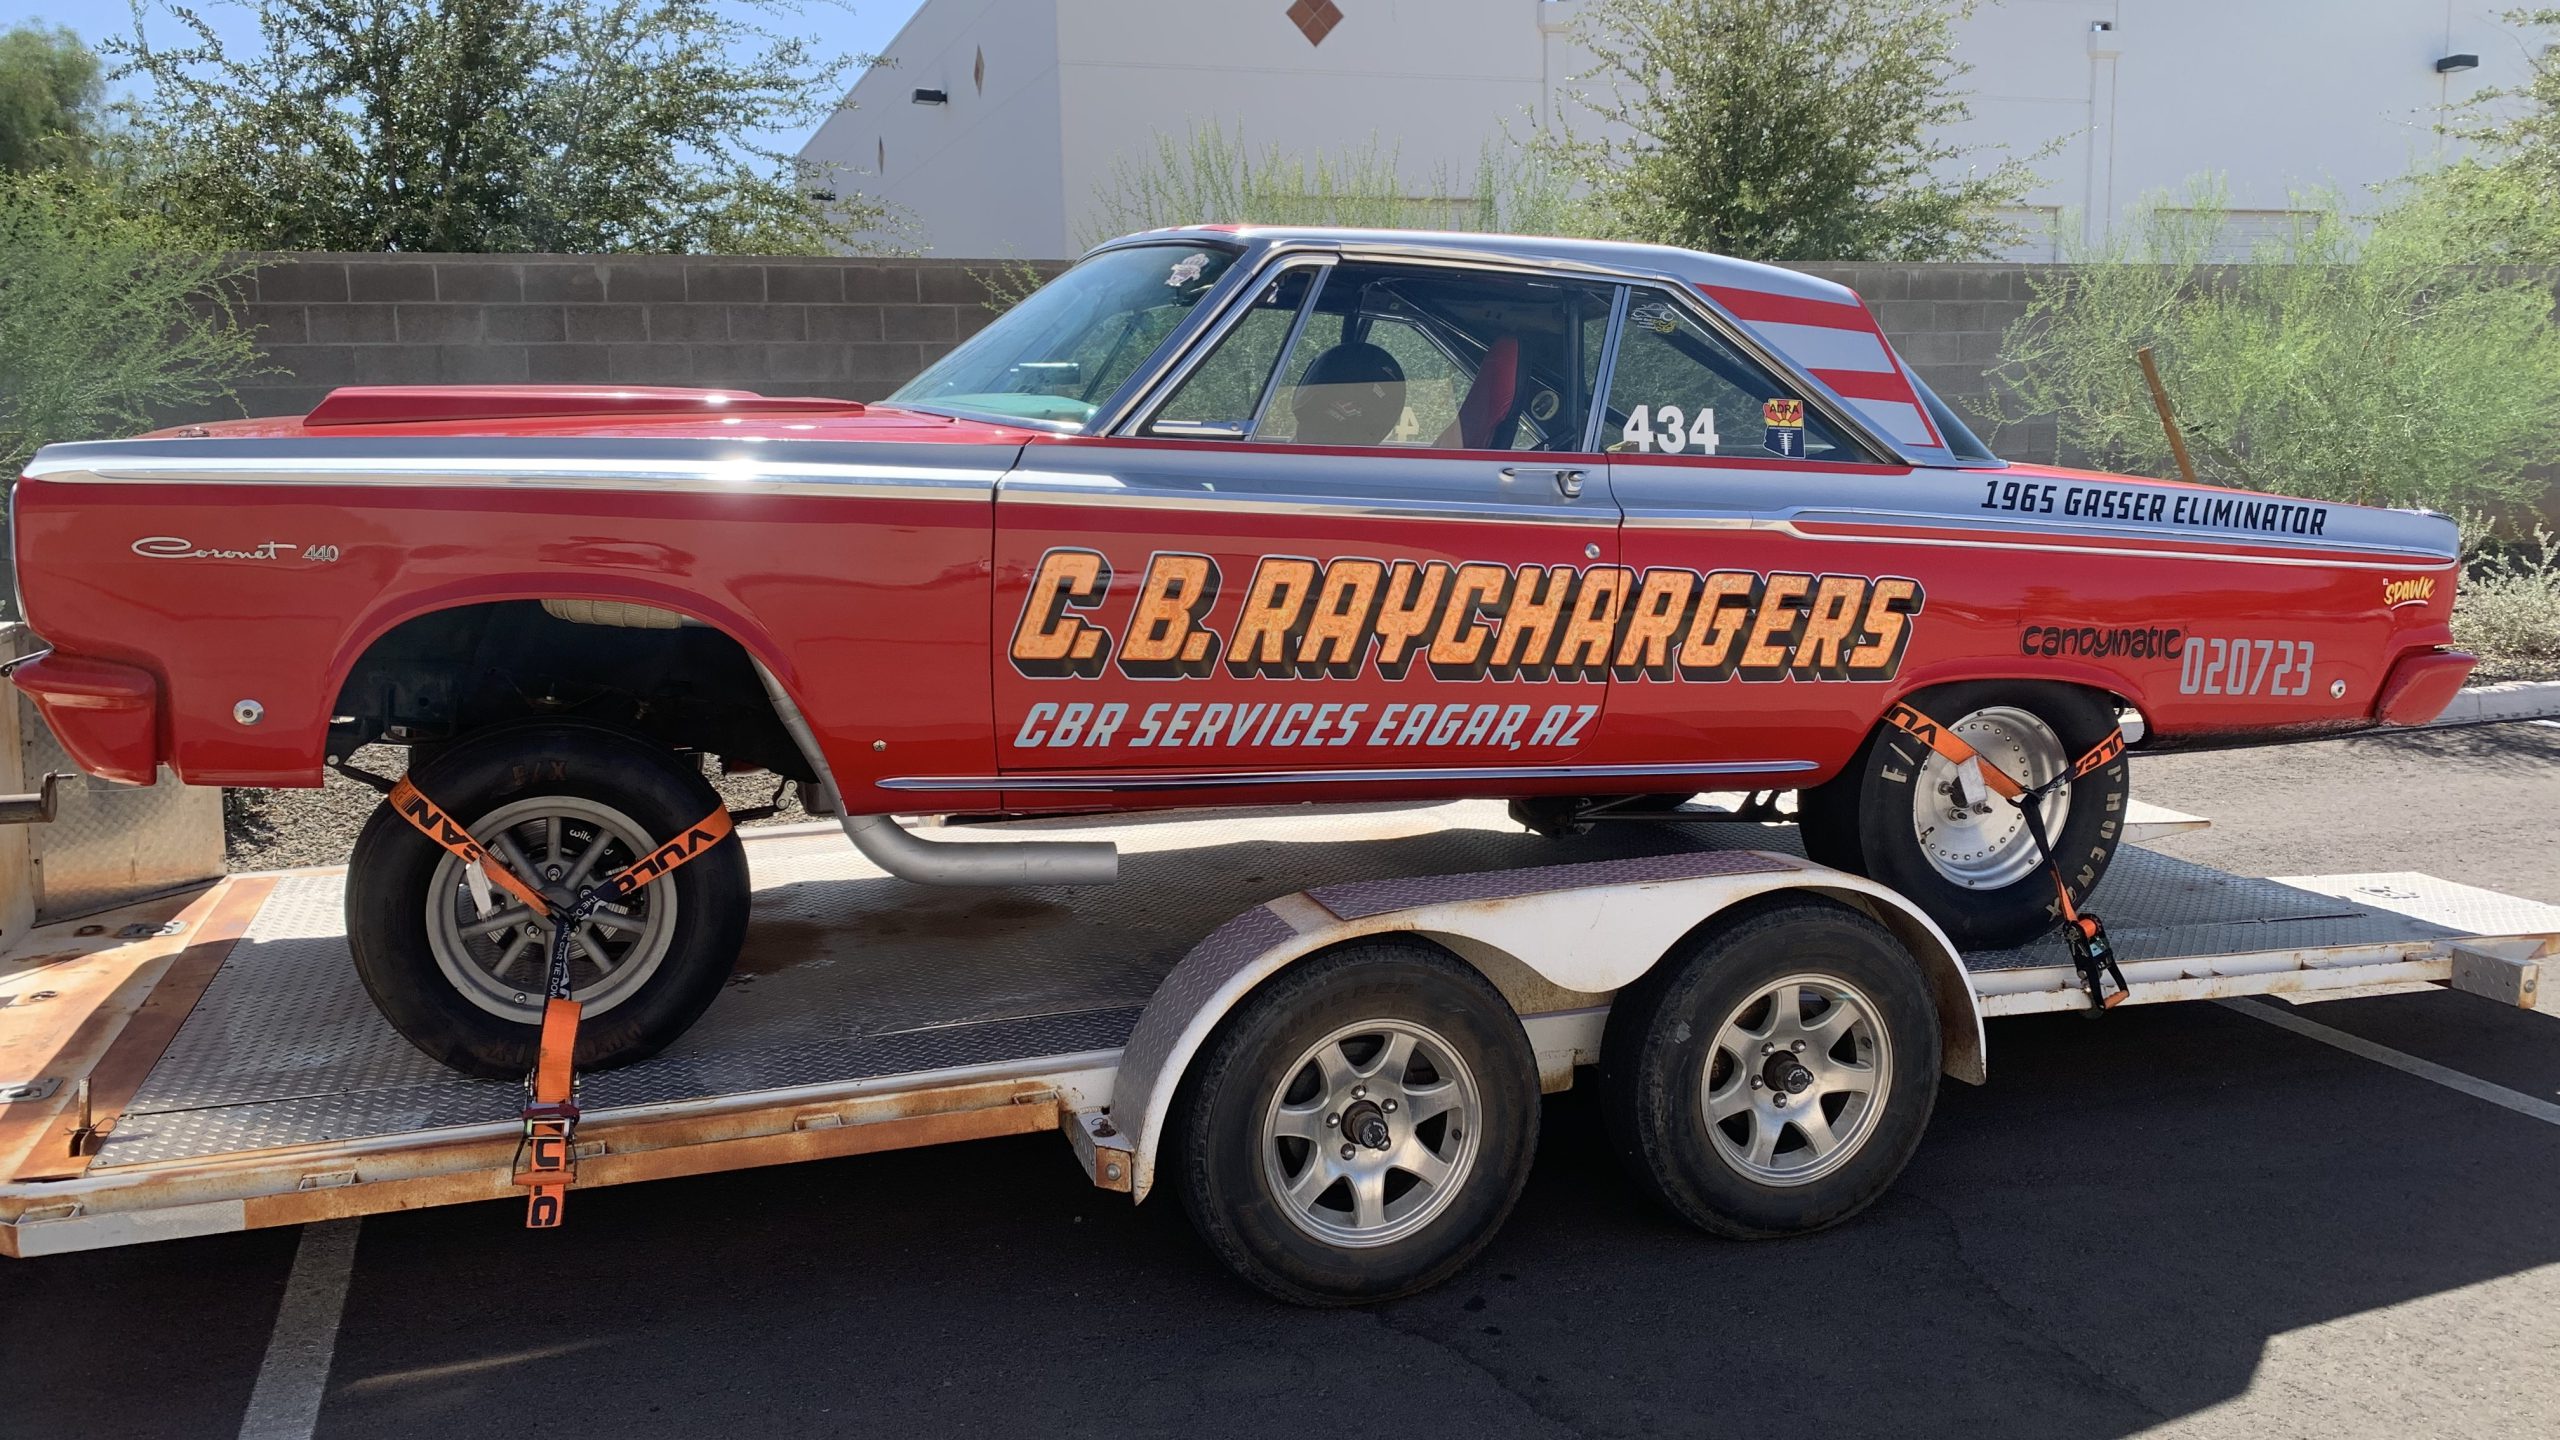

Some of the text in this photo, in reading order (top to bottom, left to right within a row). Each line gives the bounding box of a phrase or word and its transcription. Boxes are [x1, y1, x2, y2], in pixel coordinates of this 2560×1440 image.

[1623, 404, 1720, 456] 434
[1769, 403, 1800, 414] ADRA
[1981, 480, 2328, 536] 1965 GASSER ELIMINATOR
[131, 536, 340, 563] Coronet 440
[1224, 553, 1926, 684] RAYCHARGERS
[2179, 637, 2316, 696] 020723
[1013, 702, 1130, 748] CBR
[1127, 702, 1369, 747] SERVICES
[1528, 704, 1598, 746] AZ
